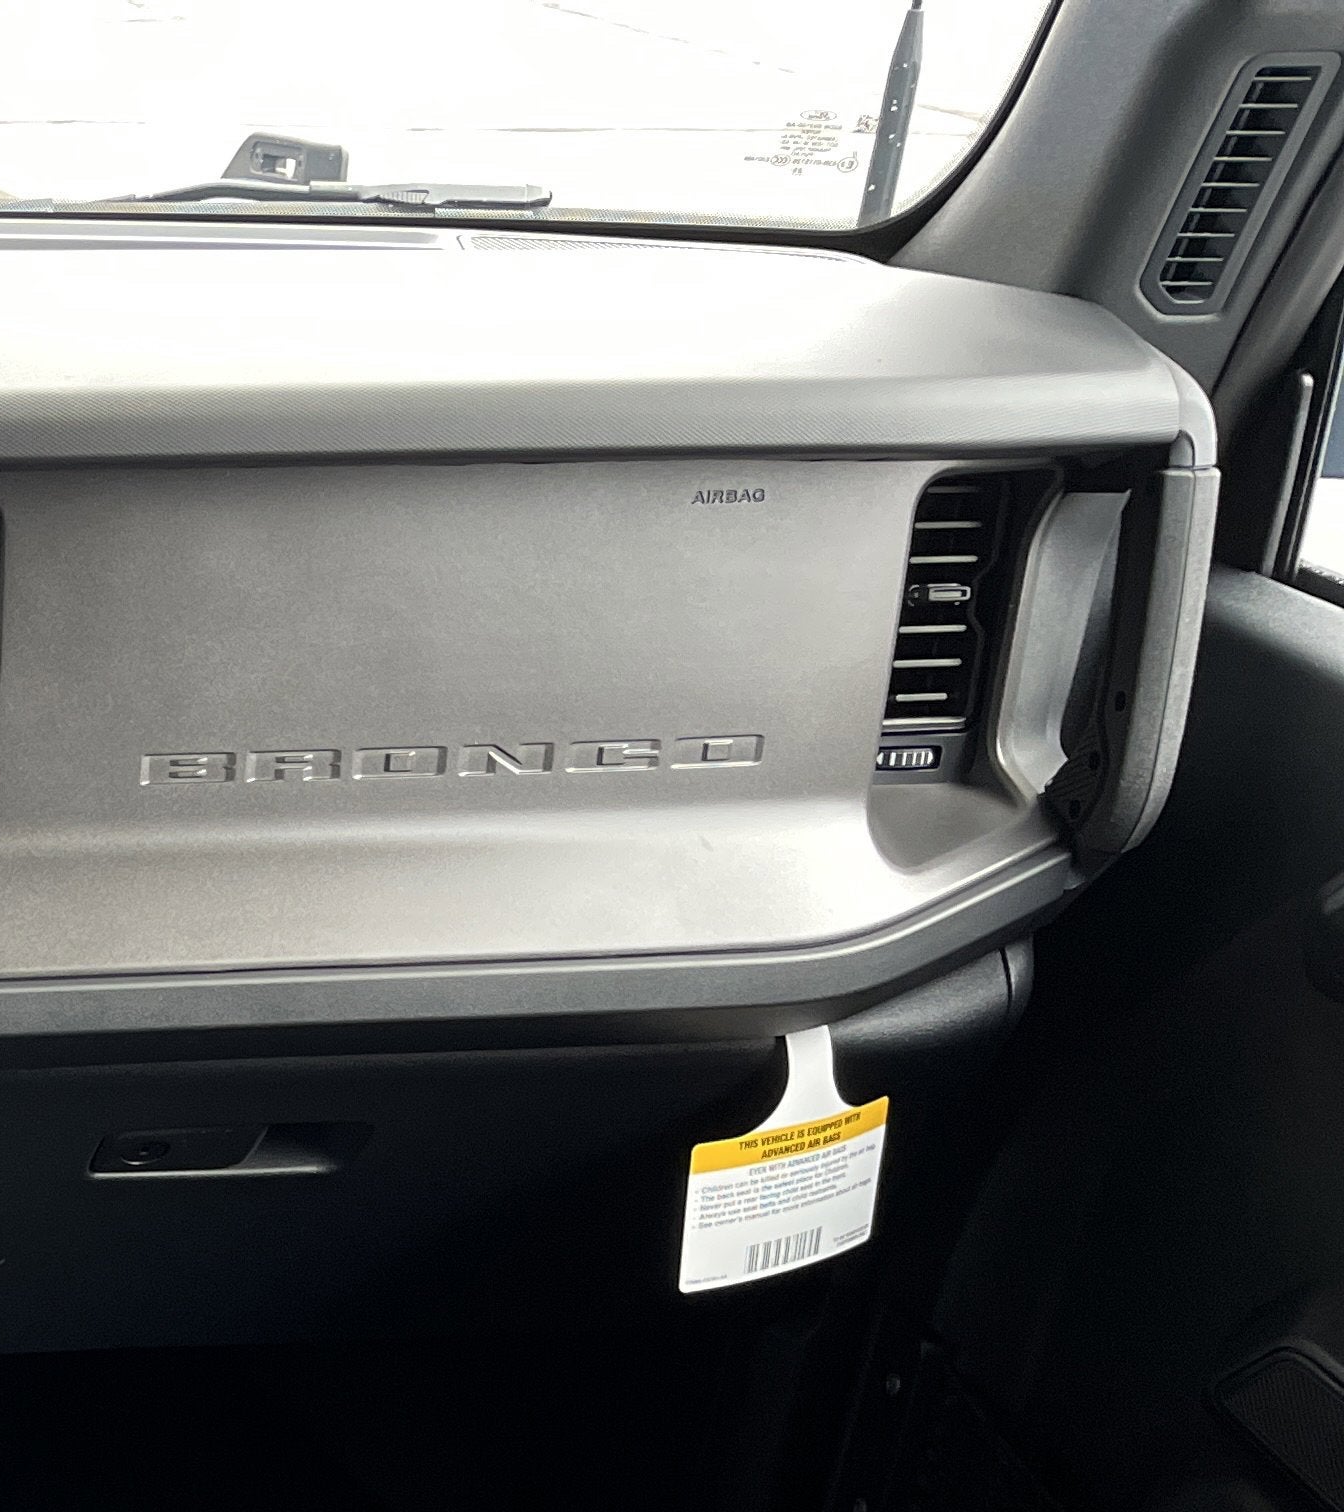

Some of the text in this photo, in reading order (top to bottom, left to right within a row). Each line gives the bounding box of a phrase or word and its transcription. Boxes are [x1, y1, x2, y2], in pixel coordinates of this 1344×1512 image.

[691, 488, 765, 504] AIRBAG
[140, 733, 765, 786] BRONCO
[738, 1112, 861, 1151] THIS VEHICLE IS EQUIPPED WITH
[761, 1132, 841, 1160] ADVANCED AIR BAGS
